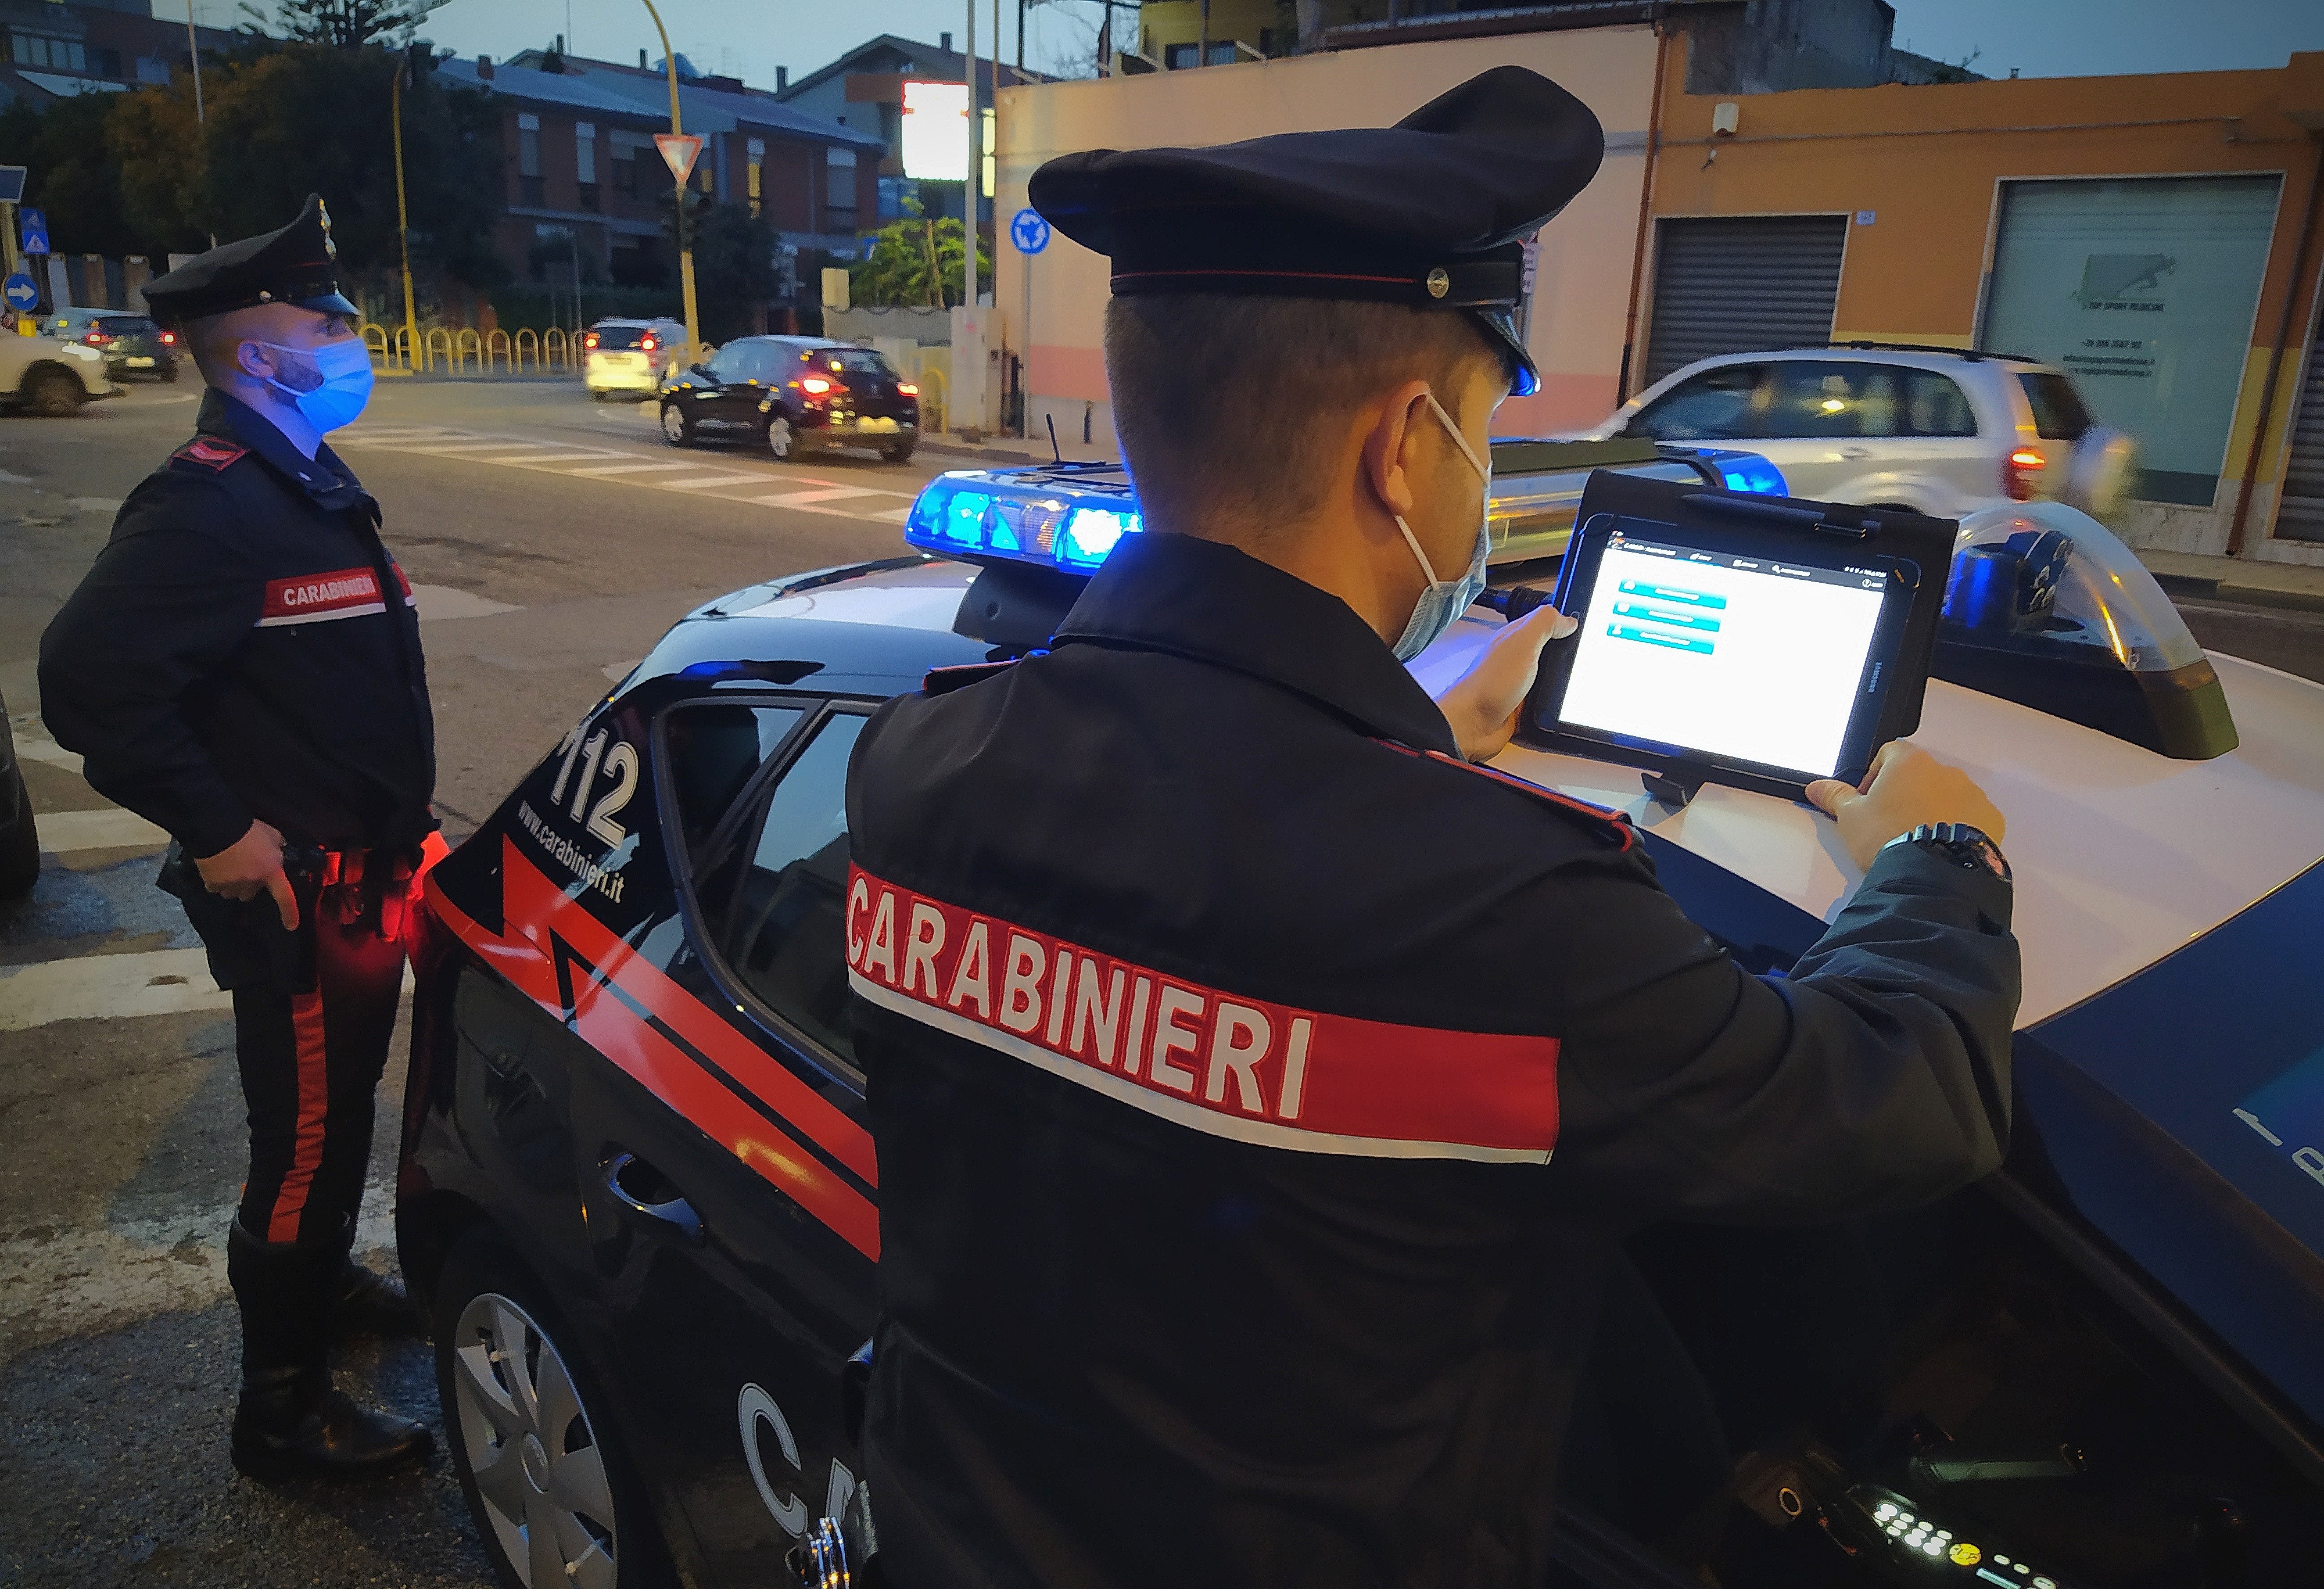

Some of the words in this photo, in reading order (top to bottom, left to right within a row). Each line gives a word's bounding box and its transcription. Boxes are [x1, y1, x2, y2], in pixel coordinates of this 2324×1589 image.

[518, 799, 624, 903] www.carabinieri.it
[551, 716, 639, 851] 112
[848, 878, 1311, 1119] CARABINIERI
